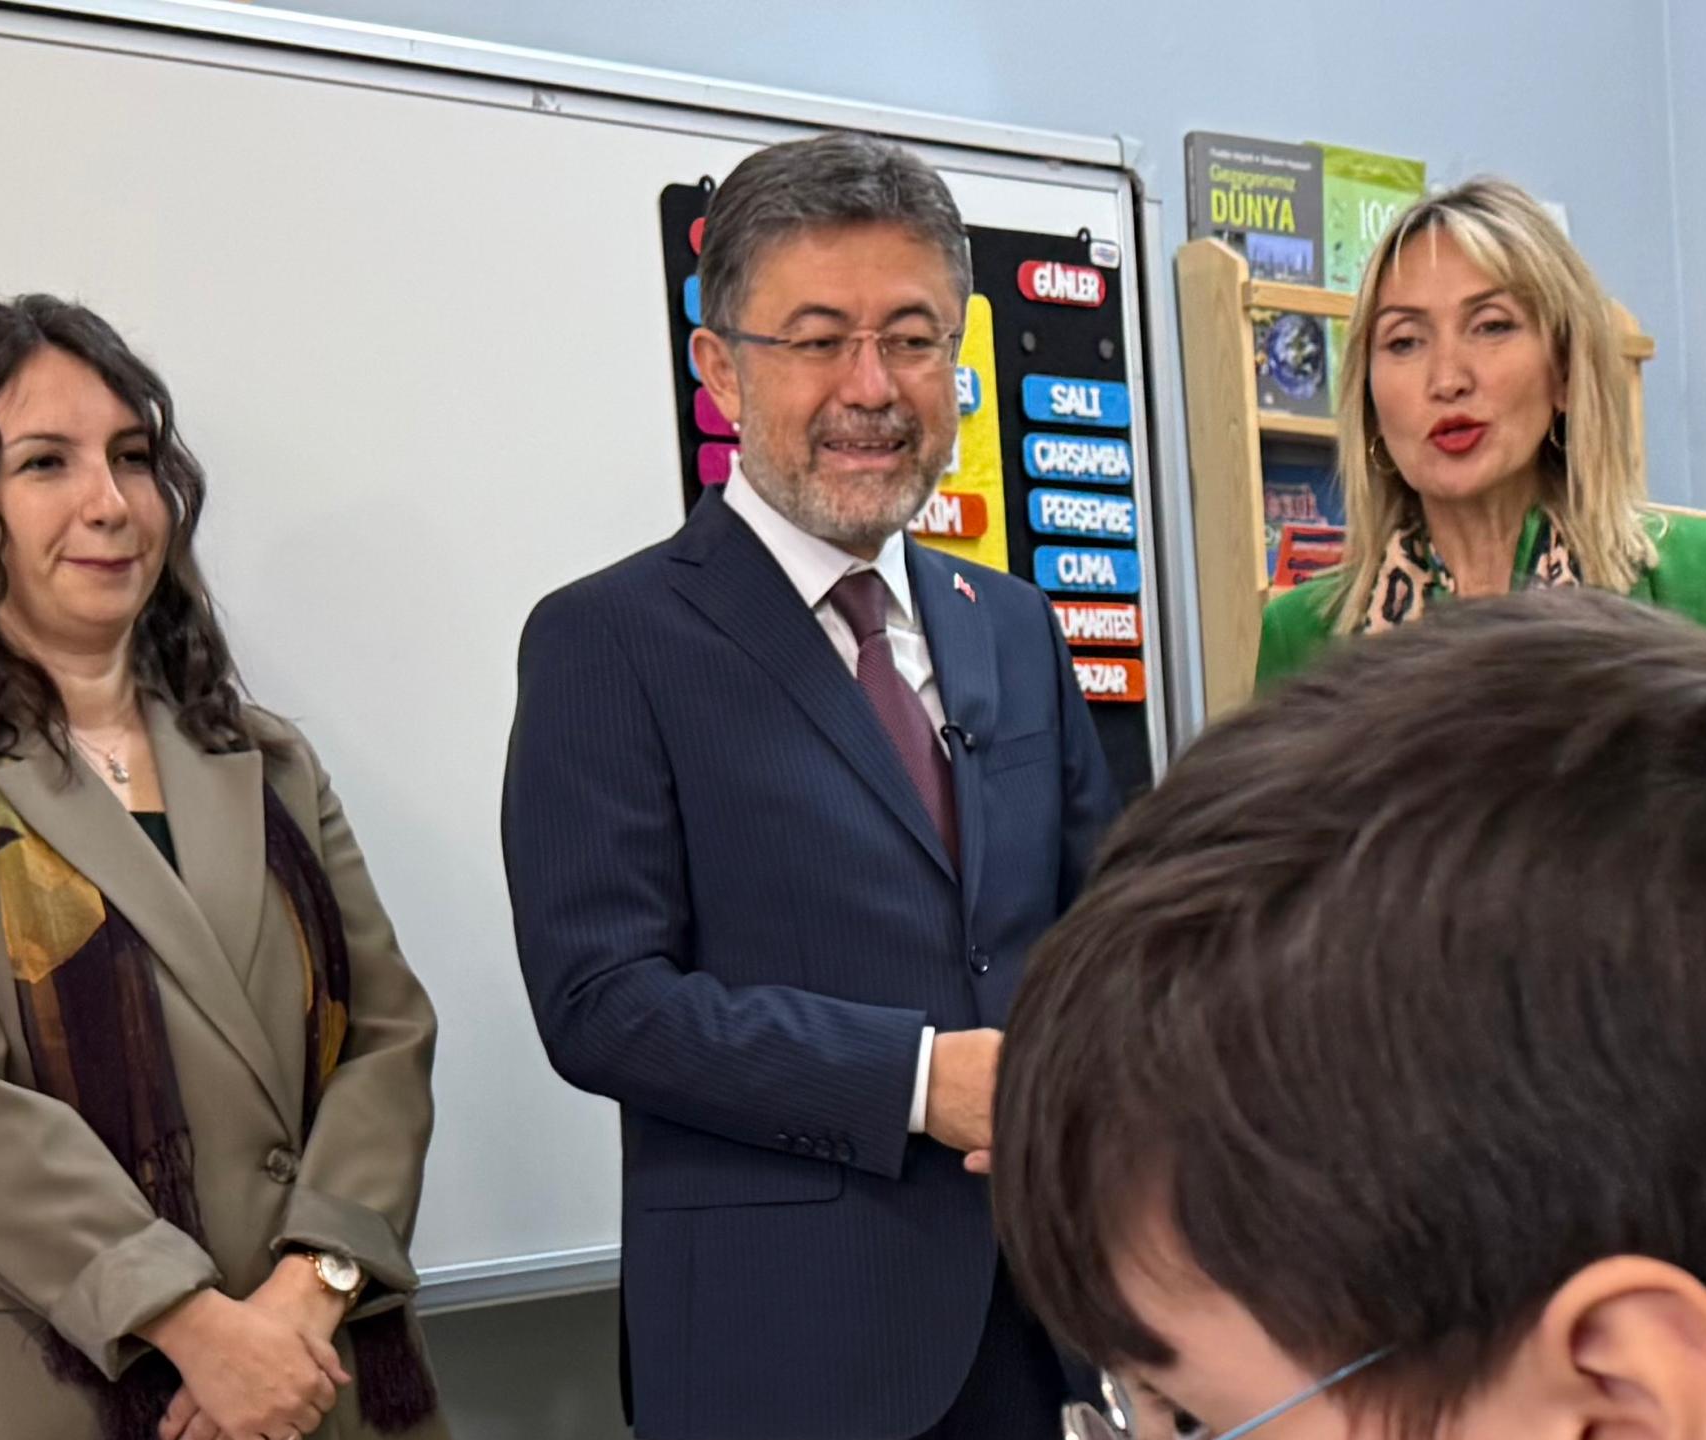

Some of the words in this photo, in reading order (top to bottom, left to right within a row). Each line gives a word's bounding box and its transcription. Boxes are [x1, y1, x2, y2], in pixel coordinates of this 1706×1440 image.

[1210, 185, 1296, 233] DÜNYA
[1033, 262, 1100, 303] GÜNLER
[1050, 382, 1103, 418] SALI
[1034, 440, 1131, 477] ÇARŞAMBA
[1040, 493, 1134, 534] PERŞEMBE
[1057, 551, 1117, 585] CUMA
[1053, 604, 1138, 641] UMARTESİ
